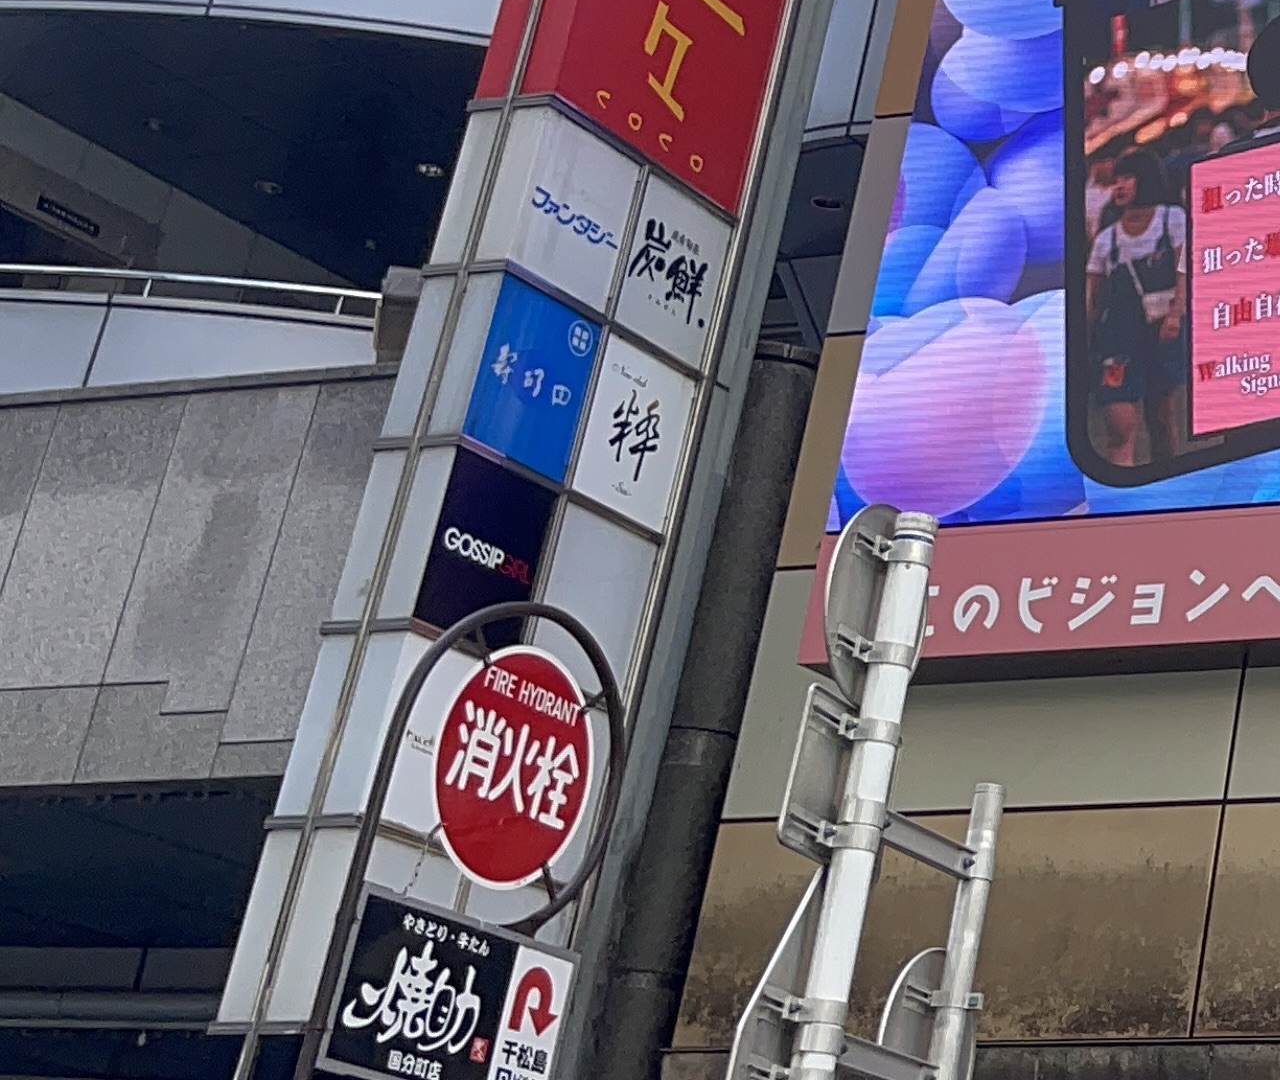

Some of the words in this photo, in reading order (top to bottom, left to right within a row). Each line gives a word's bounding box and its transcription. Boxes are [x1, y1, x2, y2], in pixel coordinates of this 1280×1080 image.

[531, 185, 618, 251] ファンタジー
[444, 526, 505, 570] GOSSIP
[484, 665, 519, 698] FIRE
[518, 680, 581, 727] HYDRANT
[444, 700, 580, 830] 消火栓
[387, 1049, 443, 1080] 国分町店
